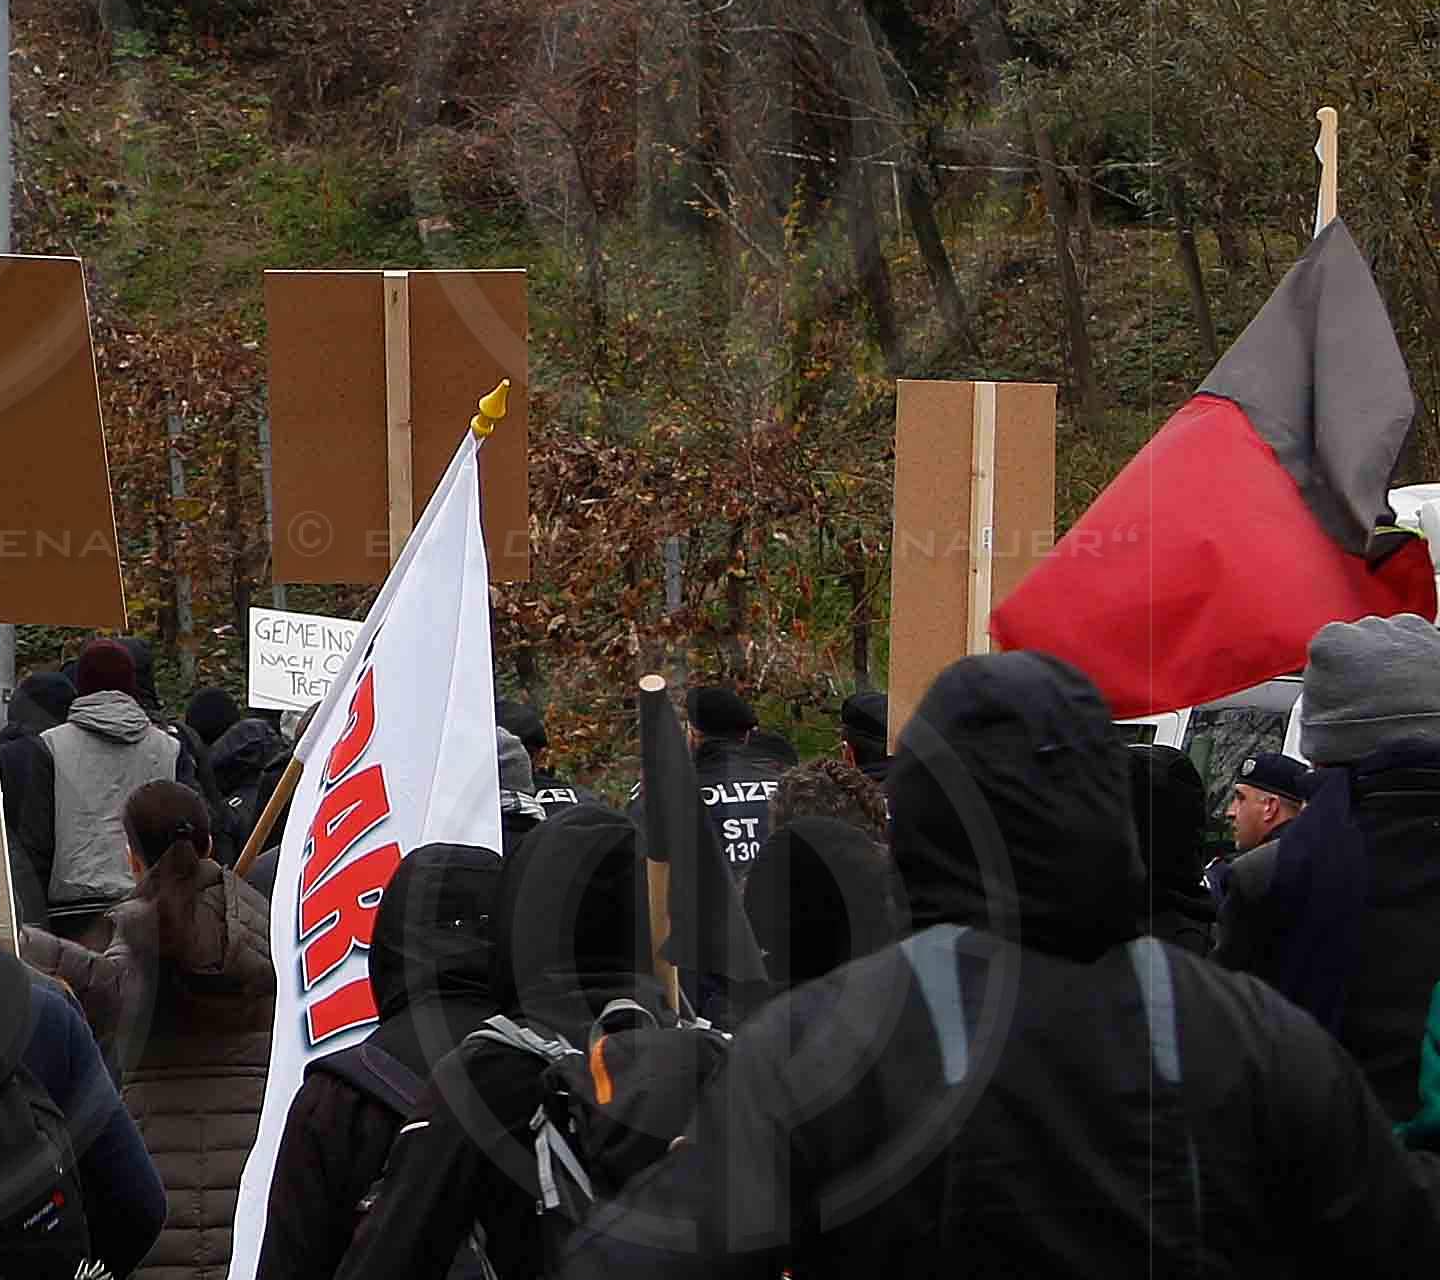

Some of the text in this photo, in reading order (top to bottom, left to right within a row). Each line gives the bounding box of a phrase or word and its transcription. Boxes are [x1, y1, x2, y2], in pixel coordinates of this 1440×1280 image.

[255, 617, 355, 653] GEMEINS
[284, 669, 333, 697] TRET
[722, 817, 759, 841] ST
[725, 840, 761, 863] 130
